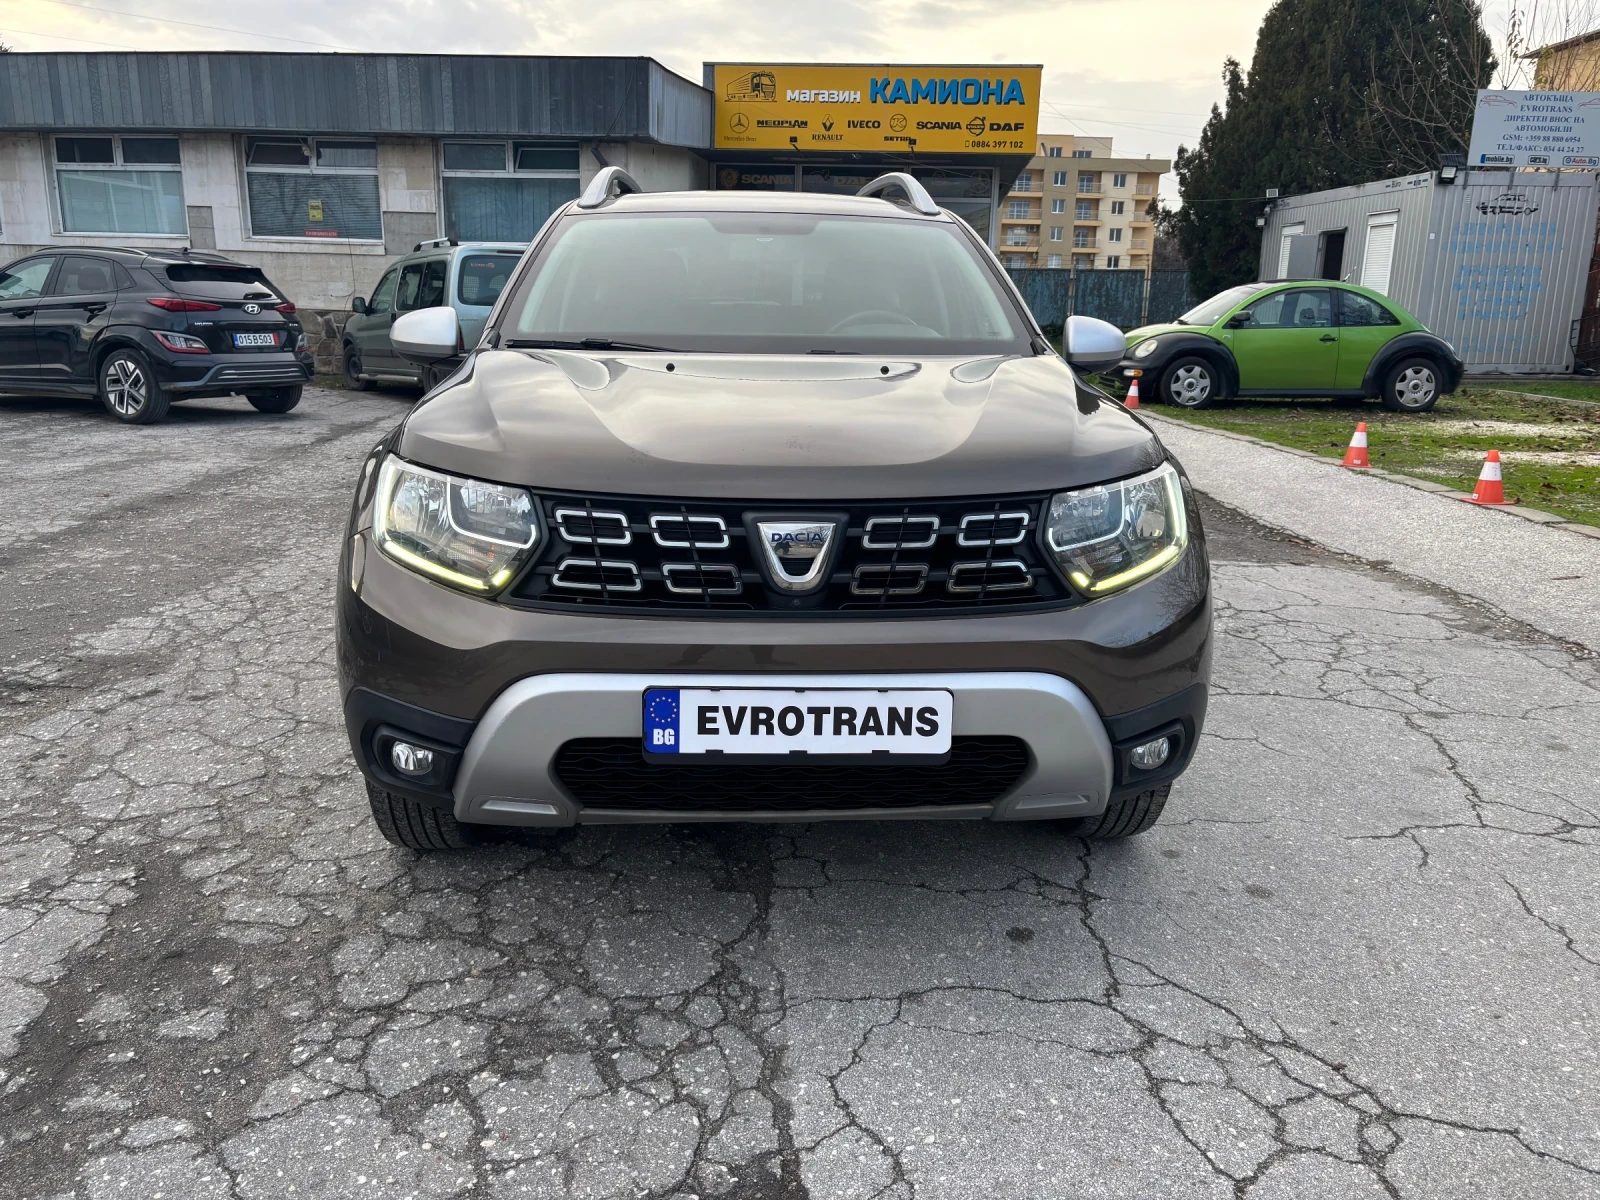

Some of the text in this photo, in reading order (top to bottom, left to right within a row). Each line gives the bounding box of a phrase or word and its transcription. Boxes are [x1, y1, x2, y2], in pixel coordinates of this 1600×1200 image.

[786, 78, 1025, 104] магазин КАМИОНА
[1523, 94, 1574, 103] АВТОКЪЩА
[1520, 105, 1573, 113] EVROTRANS
[756, 119, 808, 128] NEOPLAN
[1504, 115, 1547, 123] ДИРЕКТЕН
[848, 120, 880, 129] IVECO
[916, 121, 962, 130] SCANIA
[989, 122, 1025, 131] DAF
[1514, 125, 1572, 133] АВТОМОБИЛИ
[1497, 144, 1542, 152] ТЕЛ/ФАКС:
[1486, 155, 1513, 164] mobile.bg
[741, 174, 793, 185] SCANIA
[238, 334, 273, 345] 015B503
[771, 532, 823, 543] DACIA
[697, 705, 939, 737] EVROTRANS
[653, 729, 675, 745] BG
